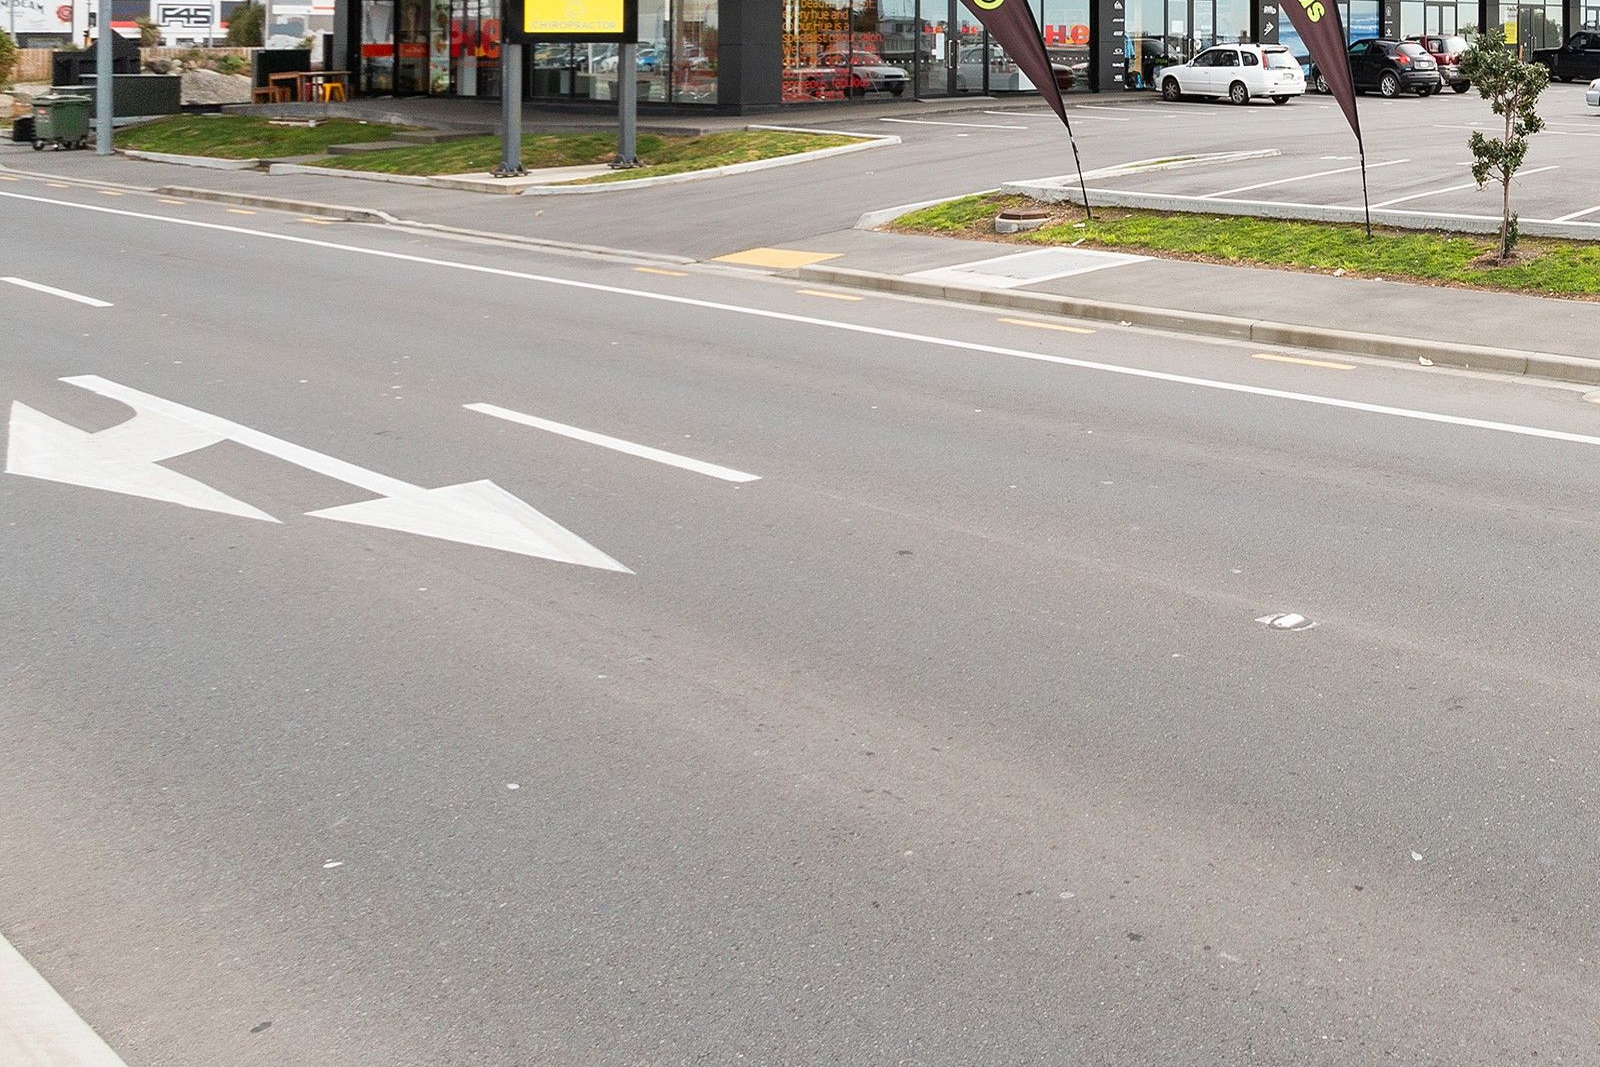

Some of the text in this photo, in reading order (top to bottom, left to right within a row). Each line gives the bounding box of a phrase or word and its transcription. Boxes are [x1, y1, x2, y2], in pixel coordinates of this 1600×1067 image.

[161, 7, 211, 24] F45
[831, 10, 849, 20] and
[531, 21, 617, 30] CHIROPRACTOR
